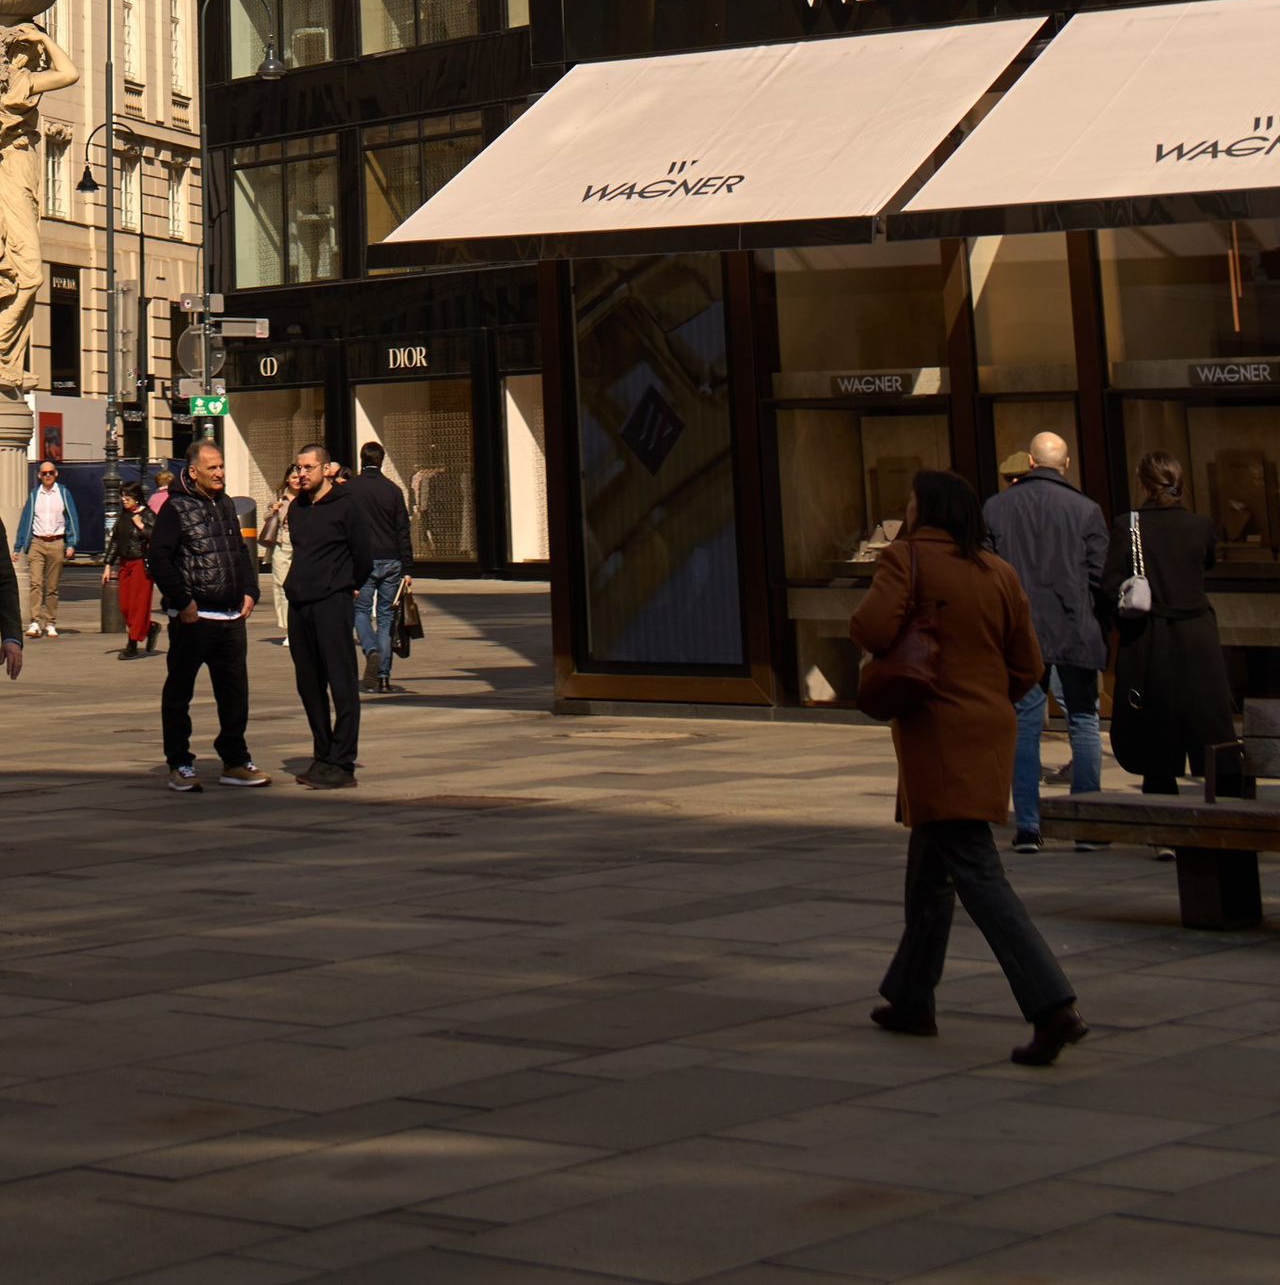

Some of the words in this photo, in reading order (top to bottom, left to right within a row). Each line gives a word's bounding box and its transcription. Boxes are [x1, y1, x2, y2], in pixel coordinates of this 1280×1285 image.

[582, 175, 745, 202] WAGNER
[388, 346, 428, 369] DIOR
[1196, 364, 1272, 382] WAGNER
[837, 376, 903, 393] WAGNER
